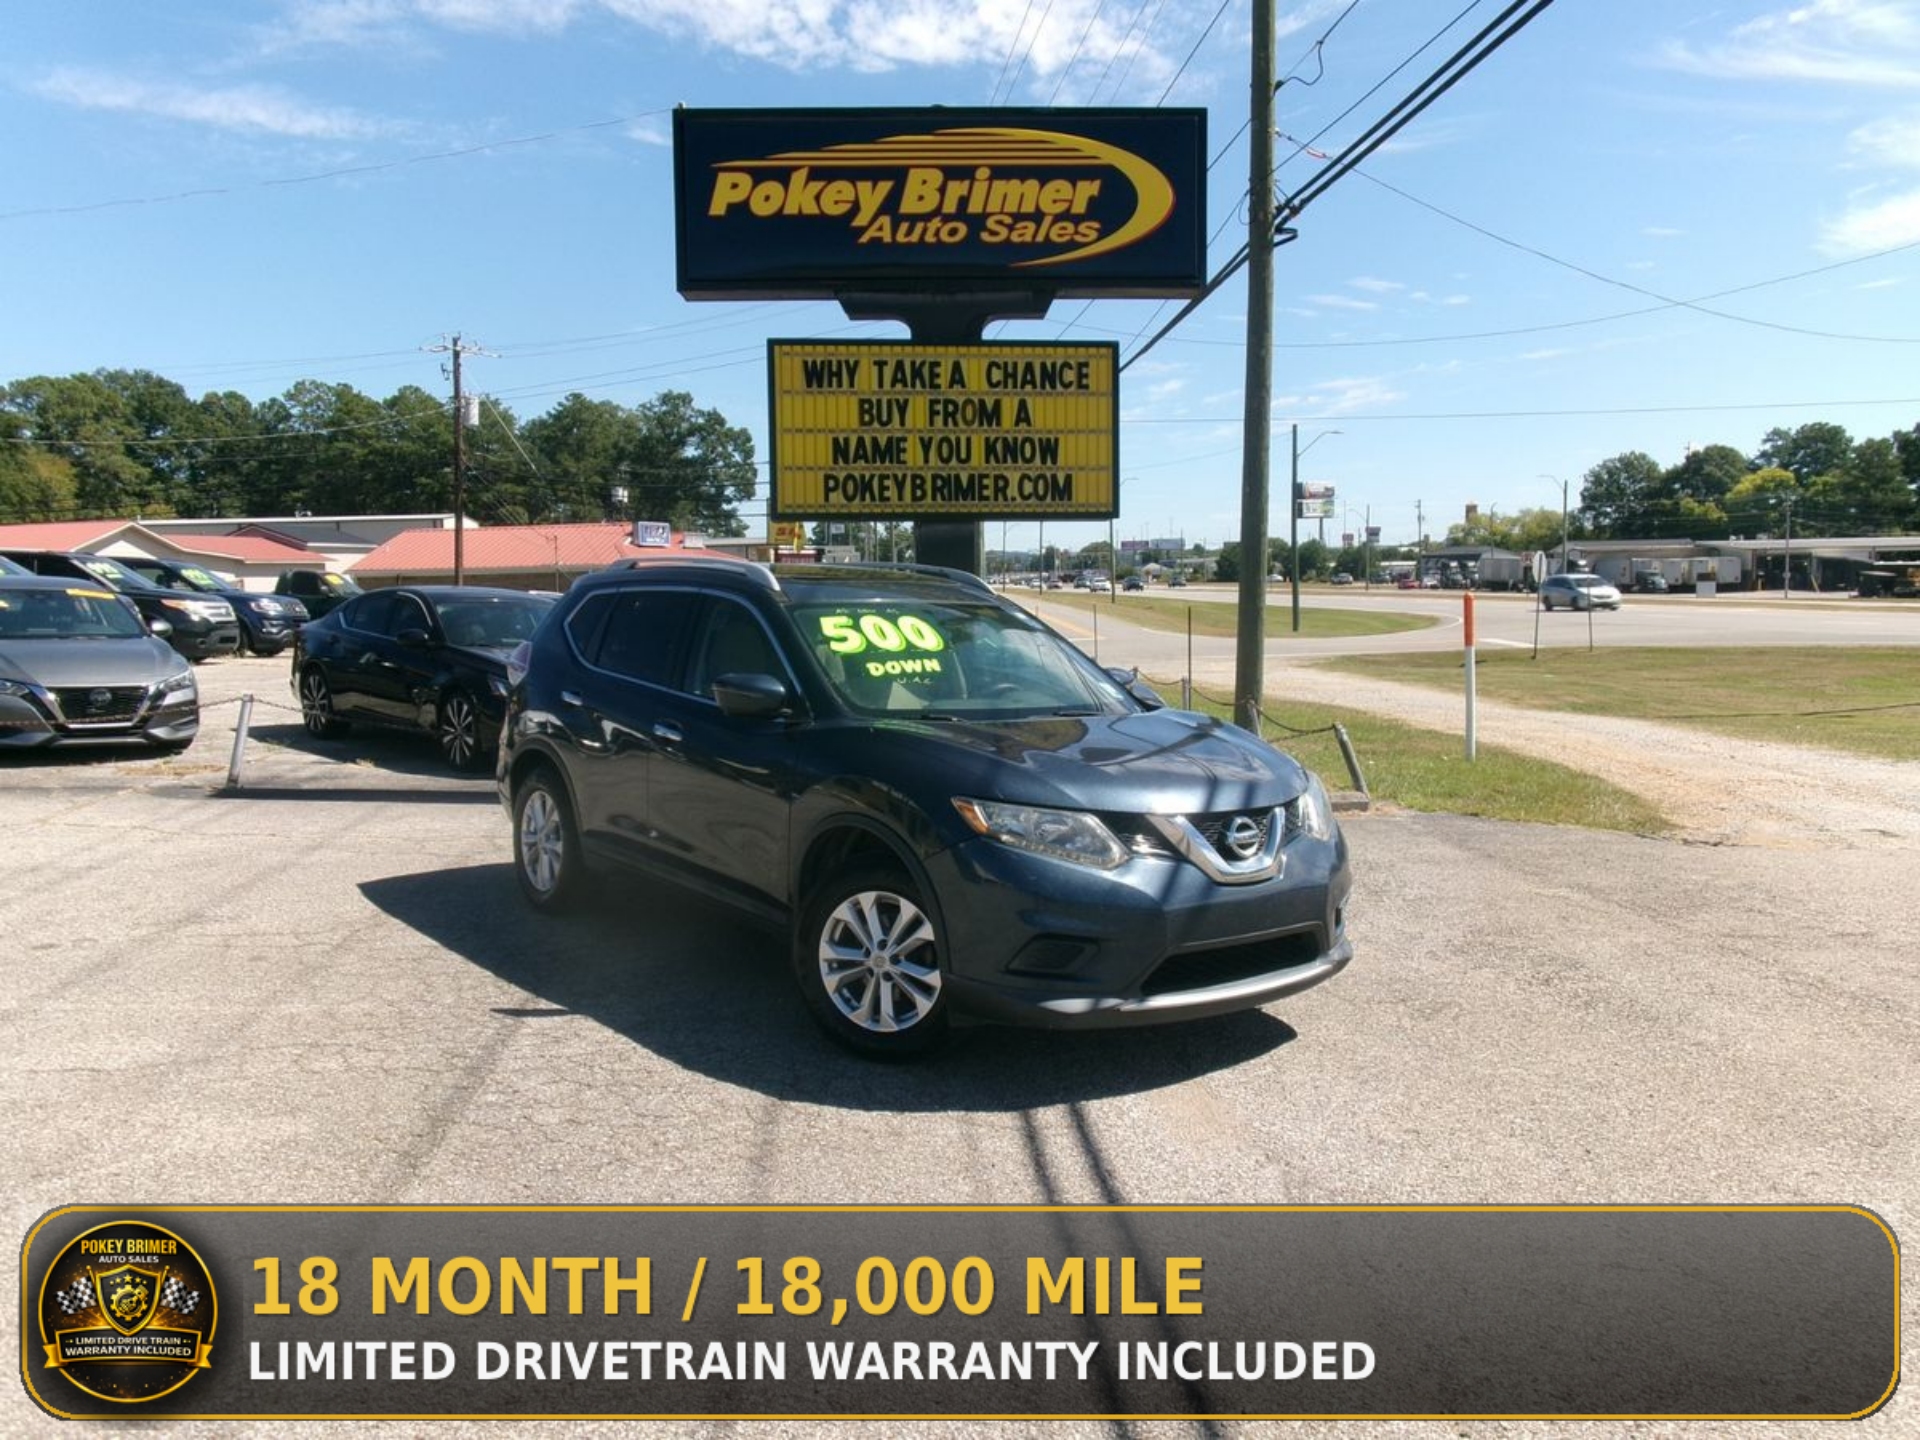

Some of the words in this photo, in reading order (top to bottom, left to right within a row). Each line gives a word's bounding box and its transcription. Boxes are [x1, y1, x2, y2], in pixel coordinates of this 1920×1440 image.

[707, 167, 894, 227] Pokey
[899, 166, 1101, 214] Brimer
[857, 215, 968, 243] Auto
[979, 214, 1101, 243] Sales
[803, 359, 859, 388] WHY
[873, 360, 942, 389] TAKE
[948, 360, 967, 389] A
[985, 361, 1090, 389] CHANCE
[858, 398, 909, 427] BUY
[928, 398, 1002, 427] FROM
[1014, 398, 1032, 427] A
[831, 436, 908, 465] NAME
[918, 436, 972, 464] YOU
[984, 436, 1060, 464] KNOW
[823, 473, 1073, 502] POKEYBRIMER.COM
[819, 614, 945, 653] 500
[865, 658, 941, 677] DOWN
